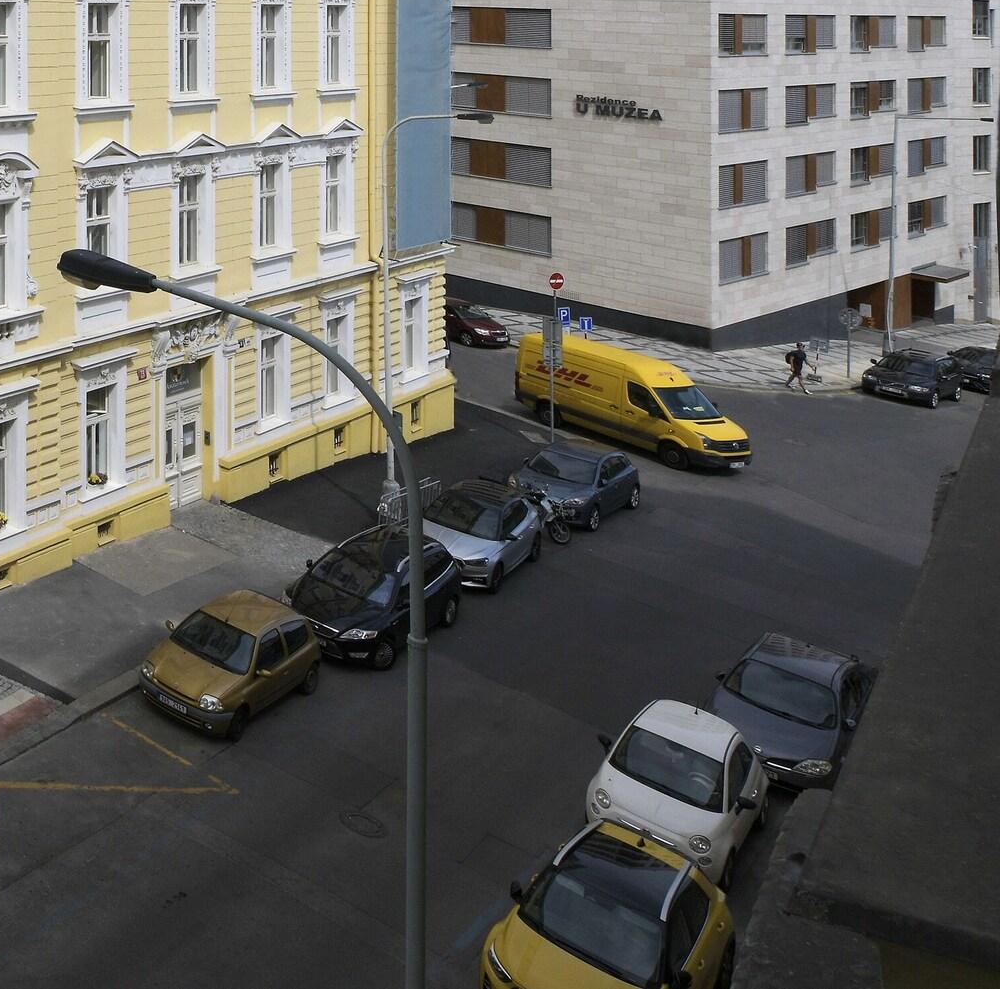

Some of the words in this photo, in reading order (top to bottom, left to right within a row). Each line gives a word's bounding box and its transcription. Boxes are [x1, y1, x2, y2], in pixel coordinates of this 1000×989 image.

[576, 94, 637, 107] Rezidence
[576, 103, 588, 115] U
[595, 105, 663, 121] MUZEA
